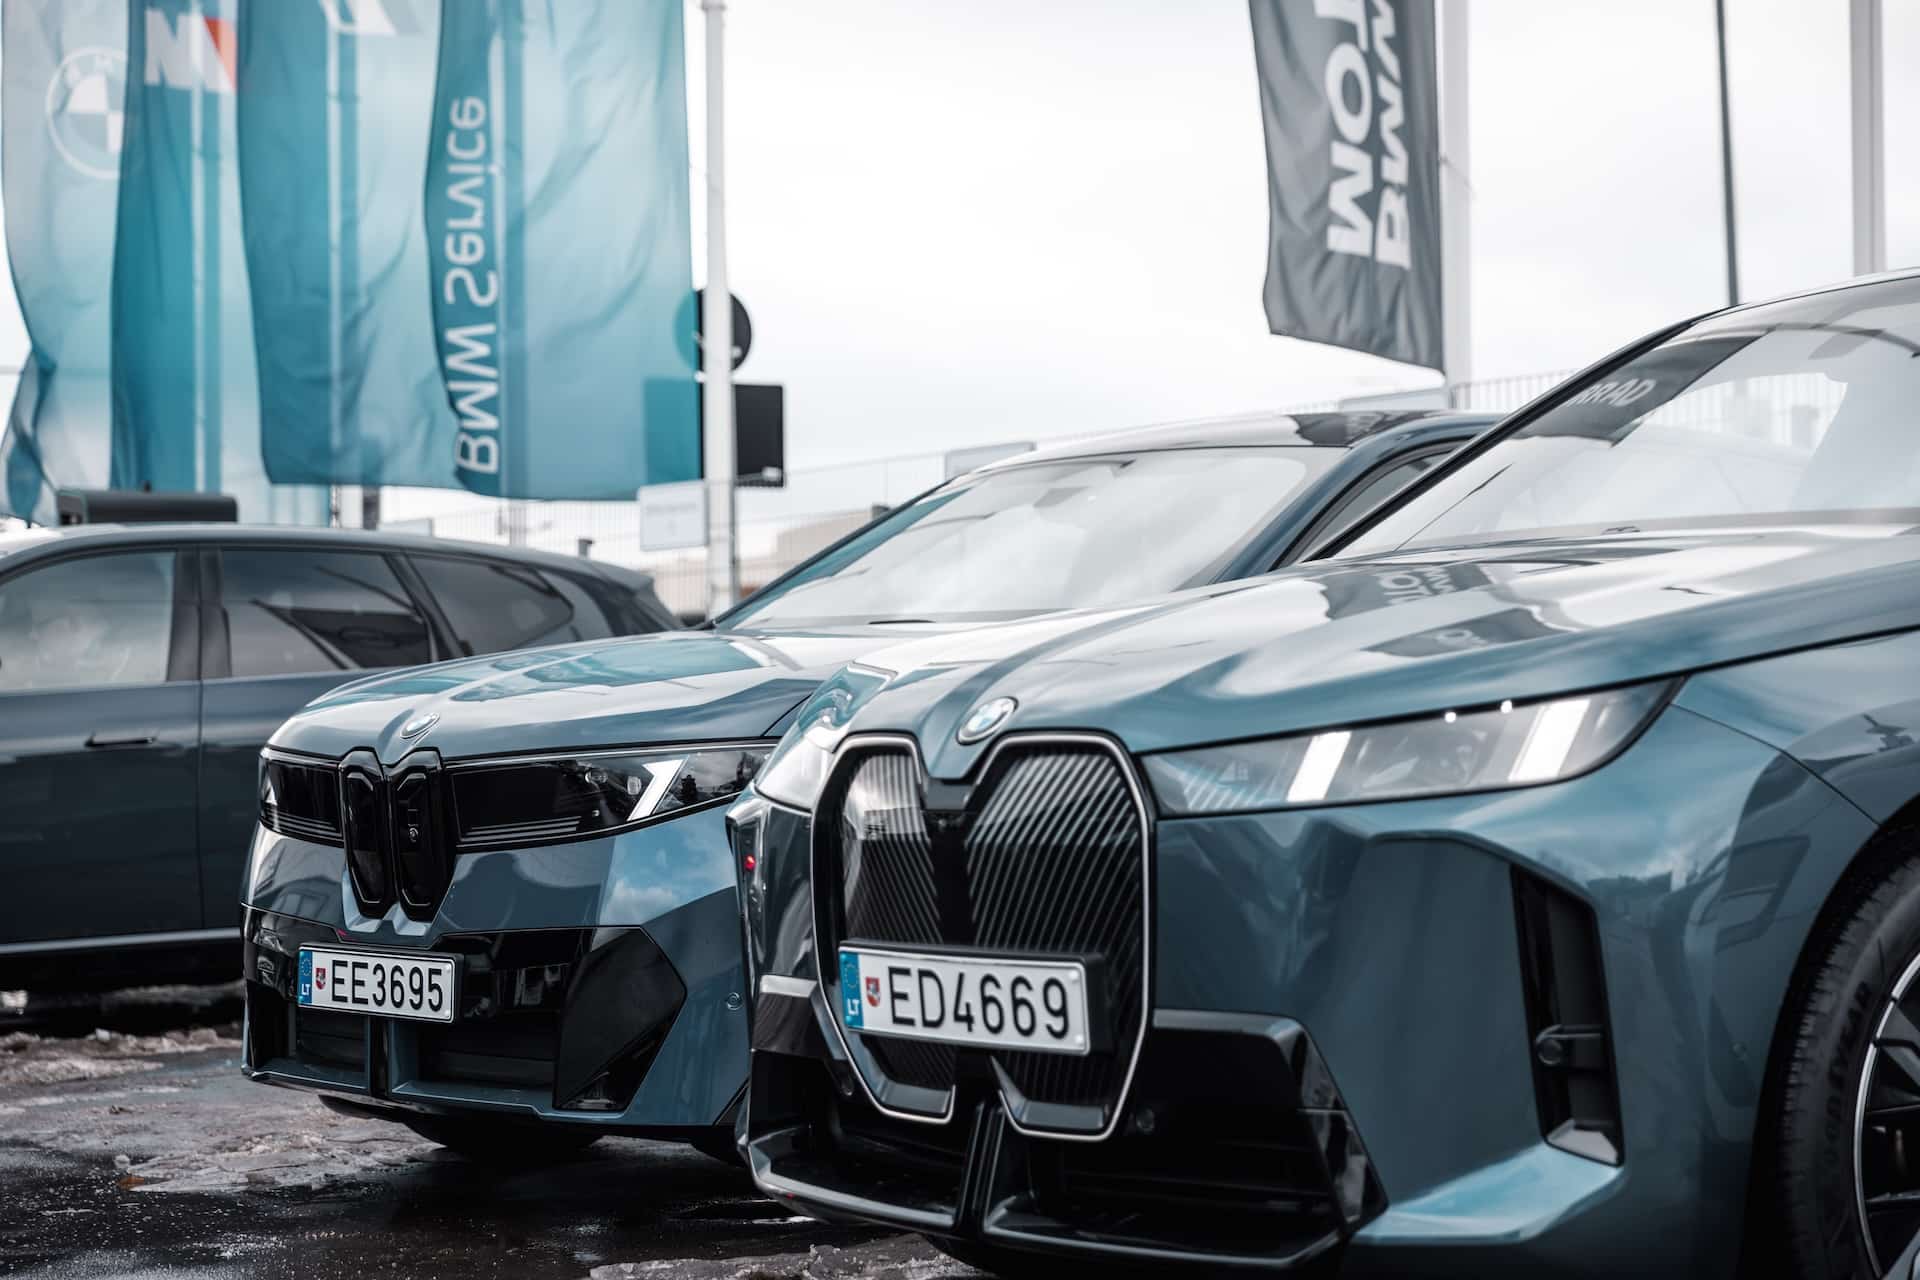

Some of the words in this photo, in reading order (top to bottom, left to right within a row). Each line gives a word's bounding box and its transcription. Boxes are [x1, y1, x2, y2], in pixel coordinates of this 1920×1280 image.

[301, 984, 311, 996] LT
[331, 959, 443, 1012] EE3695
[888, 966, 1069, 1040] ED4669
[847, 998, 859, 1016] LT
